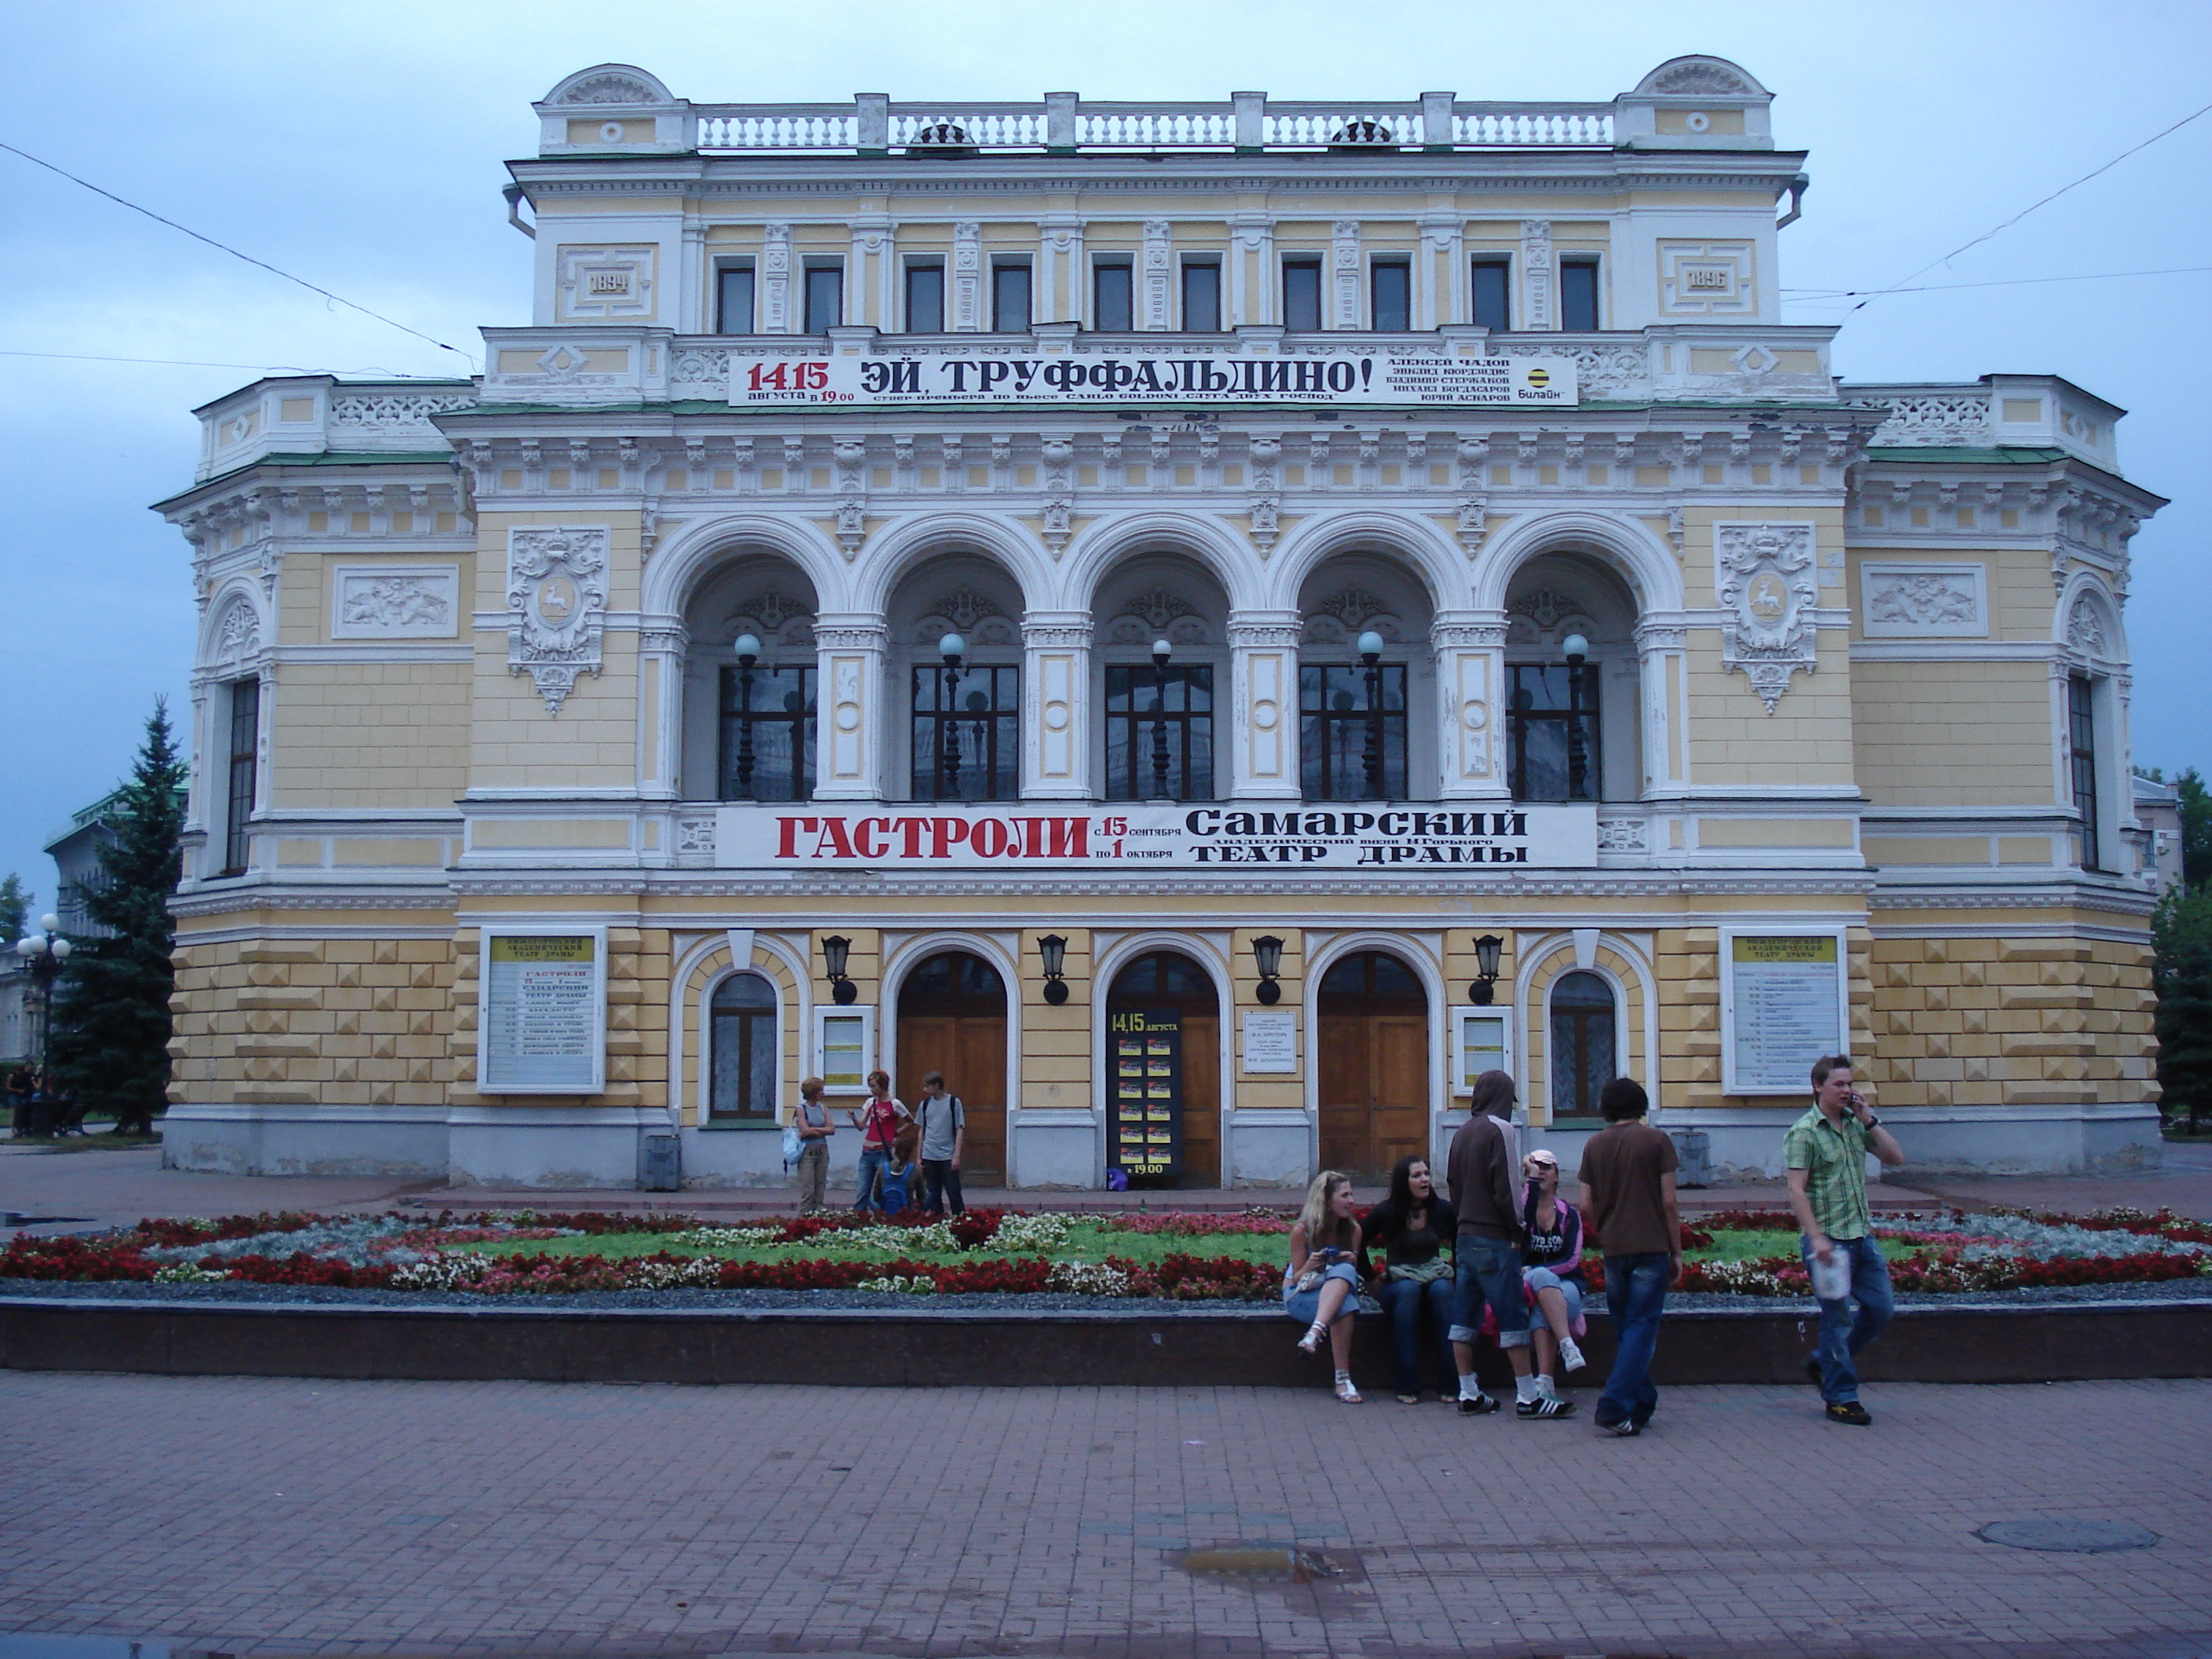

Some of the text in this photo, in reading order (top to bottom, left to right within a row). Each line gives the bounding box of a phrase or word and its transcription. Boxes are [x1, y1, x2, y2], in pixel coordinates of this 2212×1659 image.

[1688, 271, 1727, 287] 1896
[861, 357, 1372, 395] ЭЙ, ТРУФФАЛЬДИНО!
[748, 391, 806, 401] августа
[820, 390, 855, 403] 19.00
[1421, 393, 1453, 401] ЮРИЙ
[1101, 817, 1128, 837] 15
[774, 816, 1091, 859] ГАСТРОЛИ
[1111, 839, 1123, 858] 1
[1188, 845, 1529, 865] ТЕАТР ДРАМЫ
[1111, 1013, 1144, 1034] 14,15
